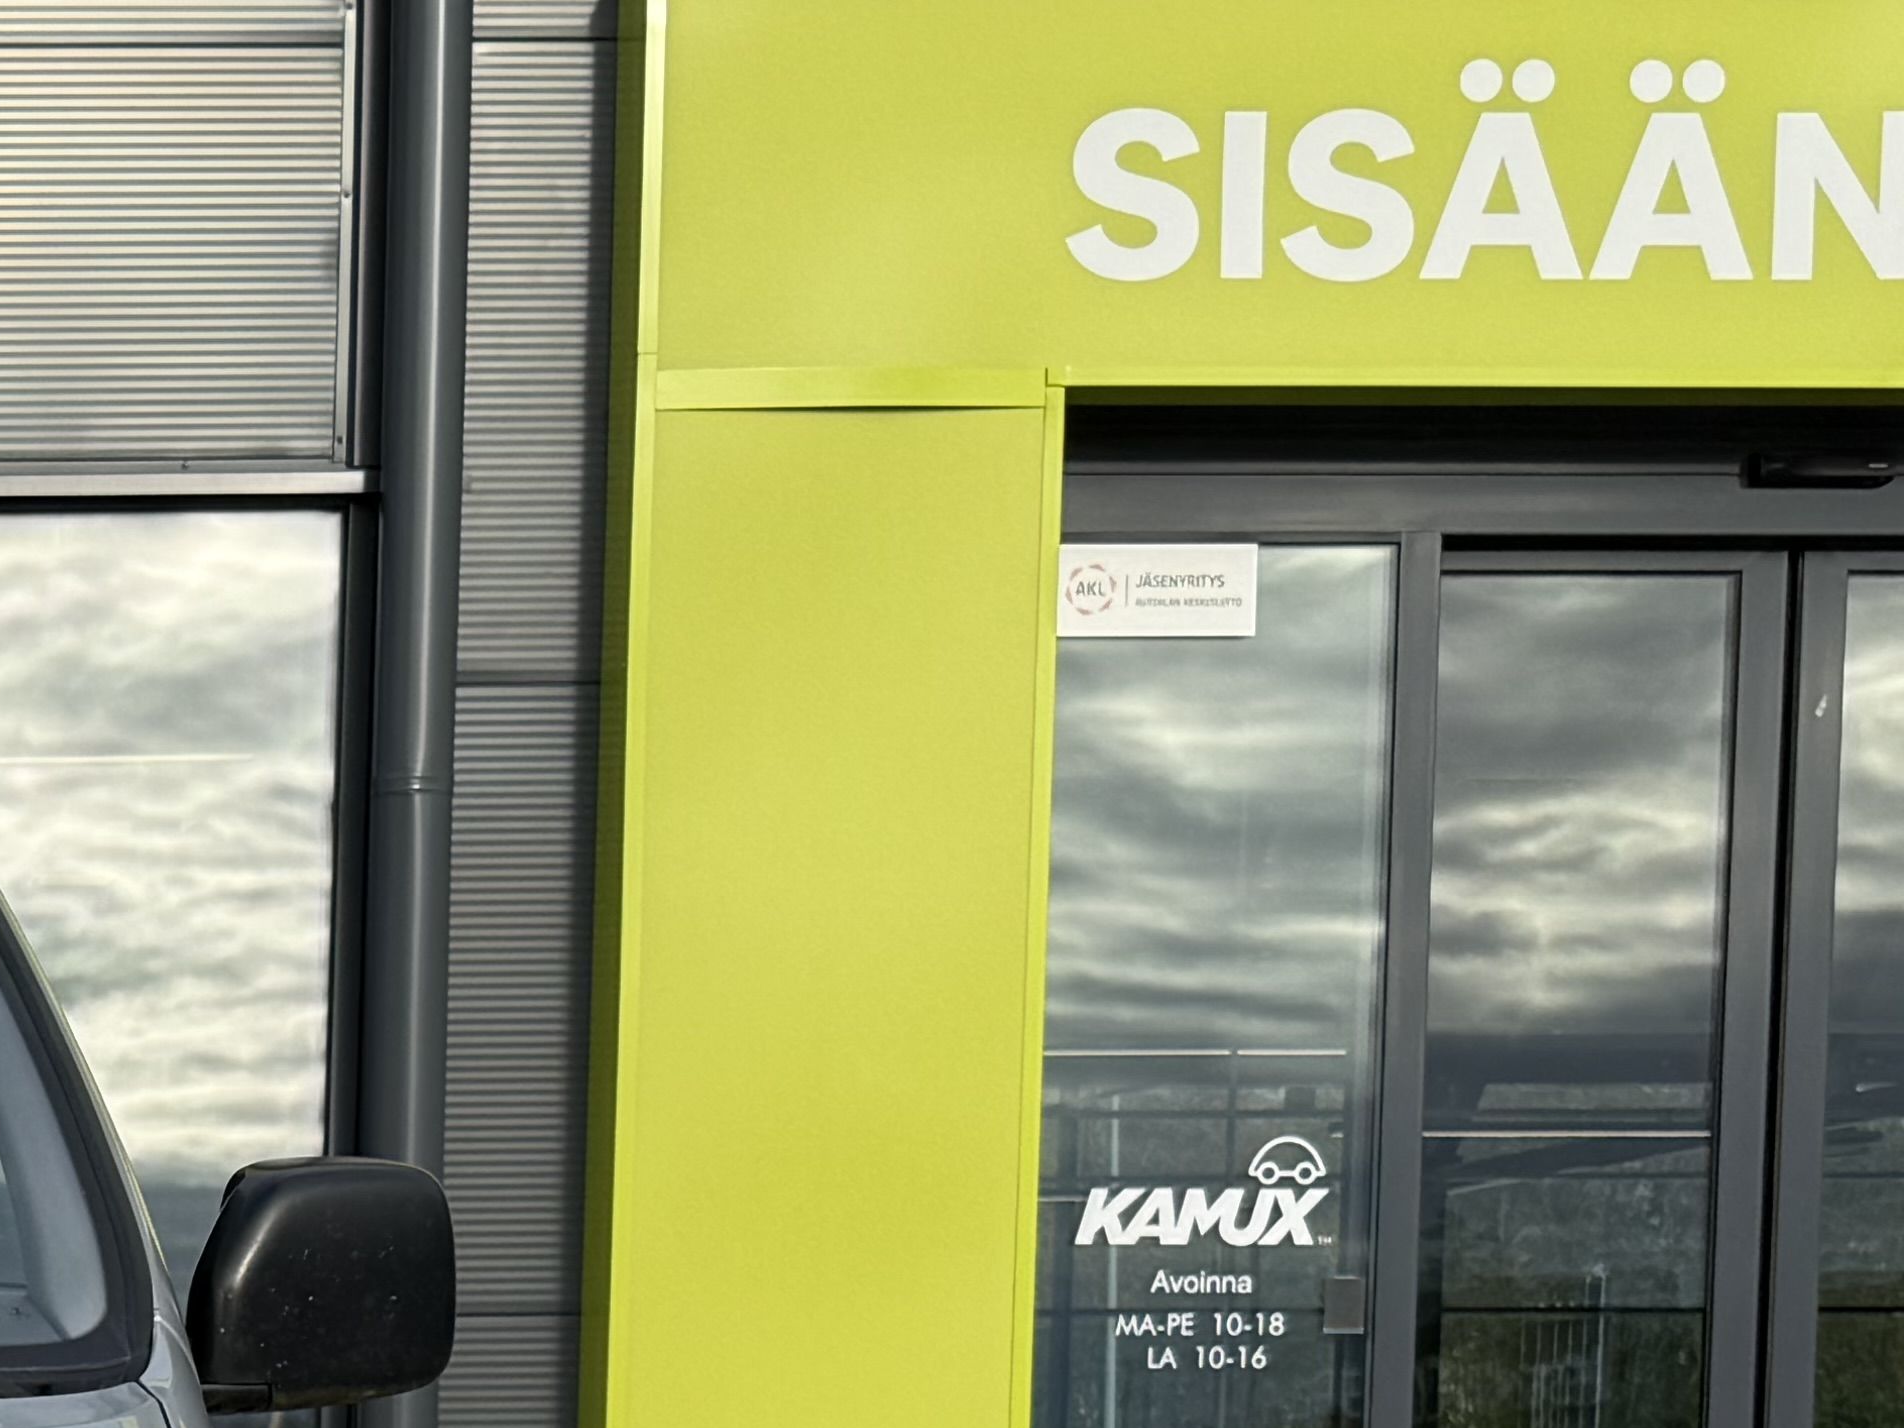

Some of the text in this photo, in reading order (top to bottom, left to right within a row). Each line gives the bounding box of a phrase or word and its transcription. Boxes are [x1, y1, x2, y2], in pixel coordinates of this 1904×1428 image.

[1064, 57, 1904, 283] SISÄÄN
[1075, 580, 1106, 597] AKL
[1135, 570, 1225, 588] JÄSENYRITYS
[1073, 1186, 1330, 1248] KAMUX
[1150, 1270, 1253, 1295] Avoinna
[1115, 1312, 1286, 1337] MA-PE 10-18
[1147, 1345, 1268, 1370] LA 10-16
